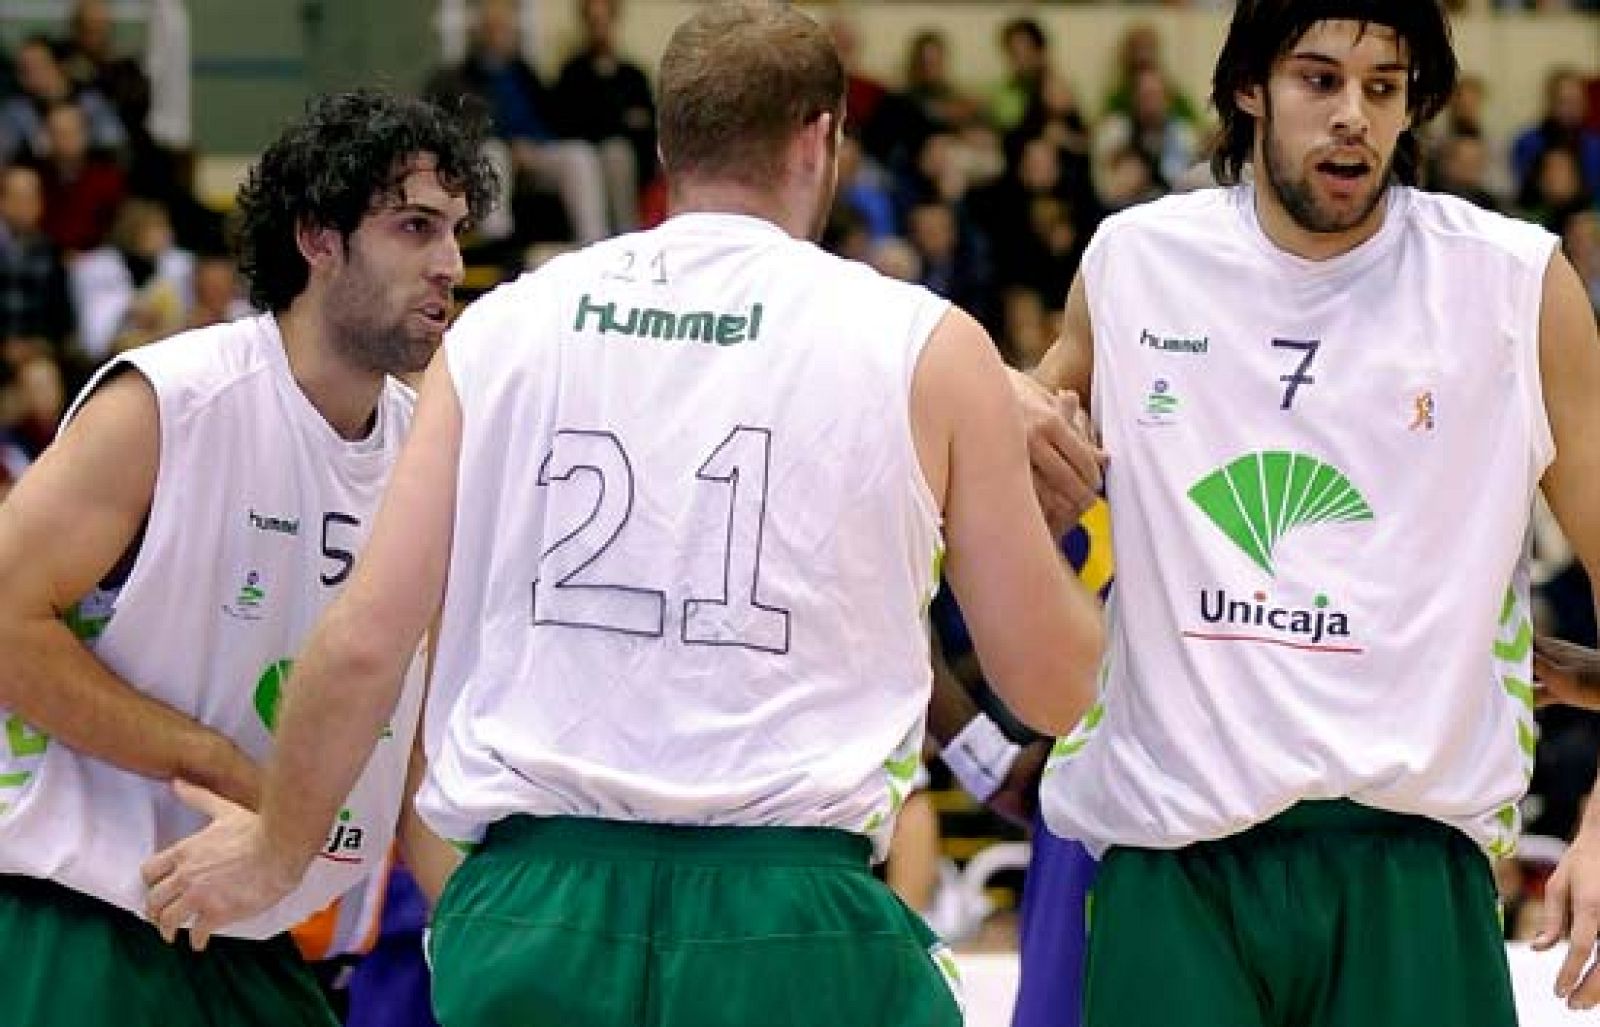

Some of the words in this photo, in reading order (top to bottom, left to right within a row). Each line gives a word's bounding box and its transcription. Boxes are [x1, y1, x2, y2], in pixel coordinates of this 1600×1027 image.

[574, 294, 763, 346] hummel
[1271, 338, 1321, 411] 7
[319, 511, 361, 586] 5
[532, 424, 791, 655] 21
[1200, 589, 1350, 643] Unicaja
